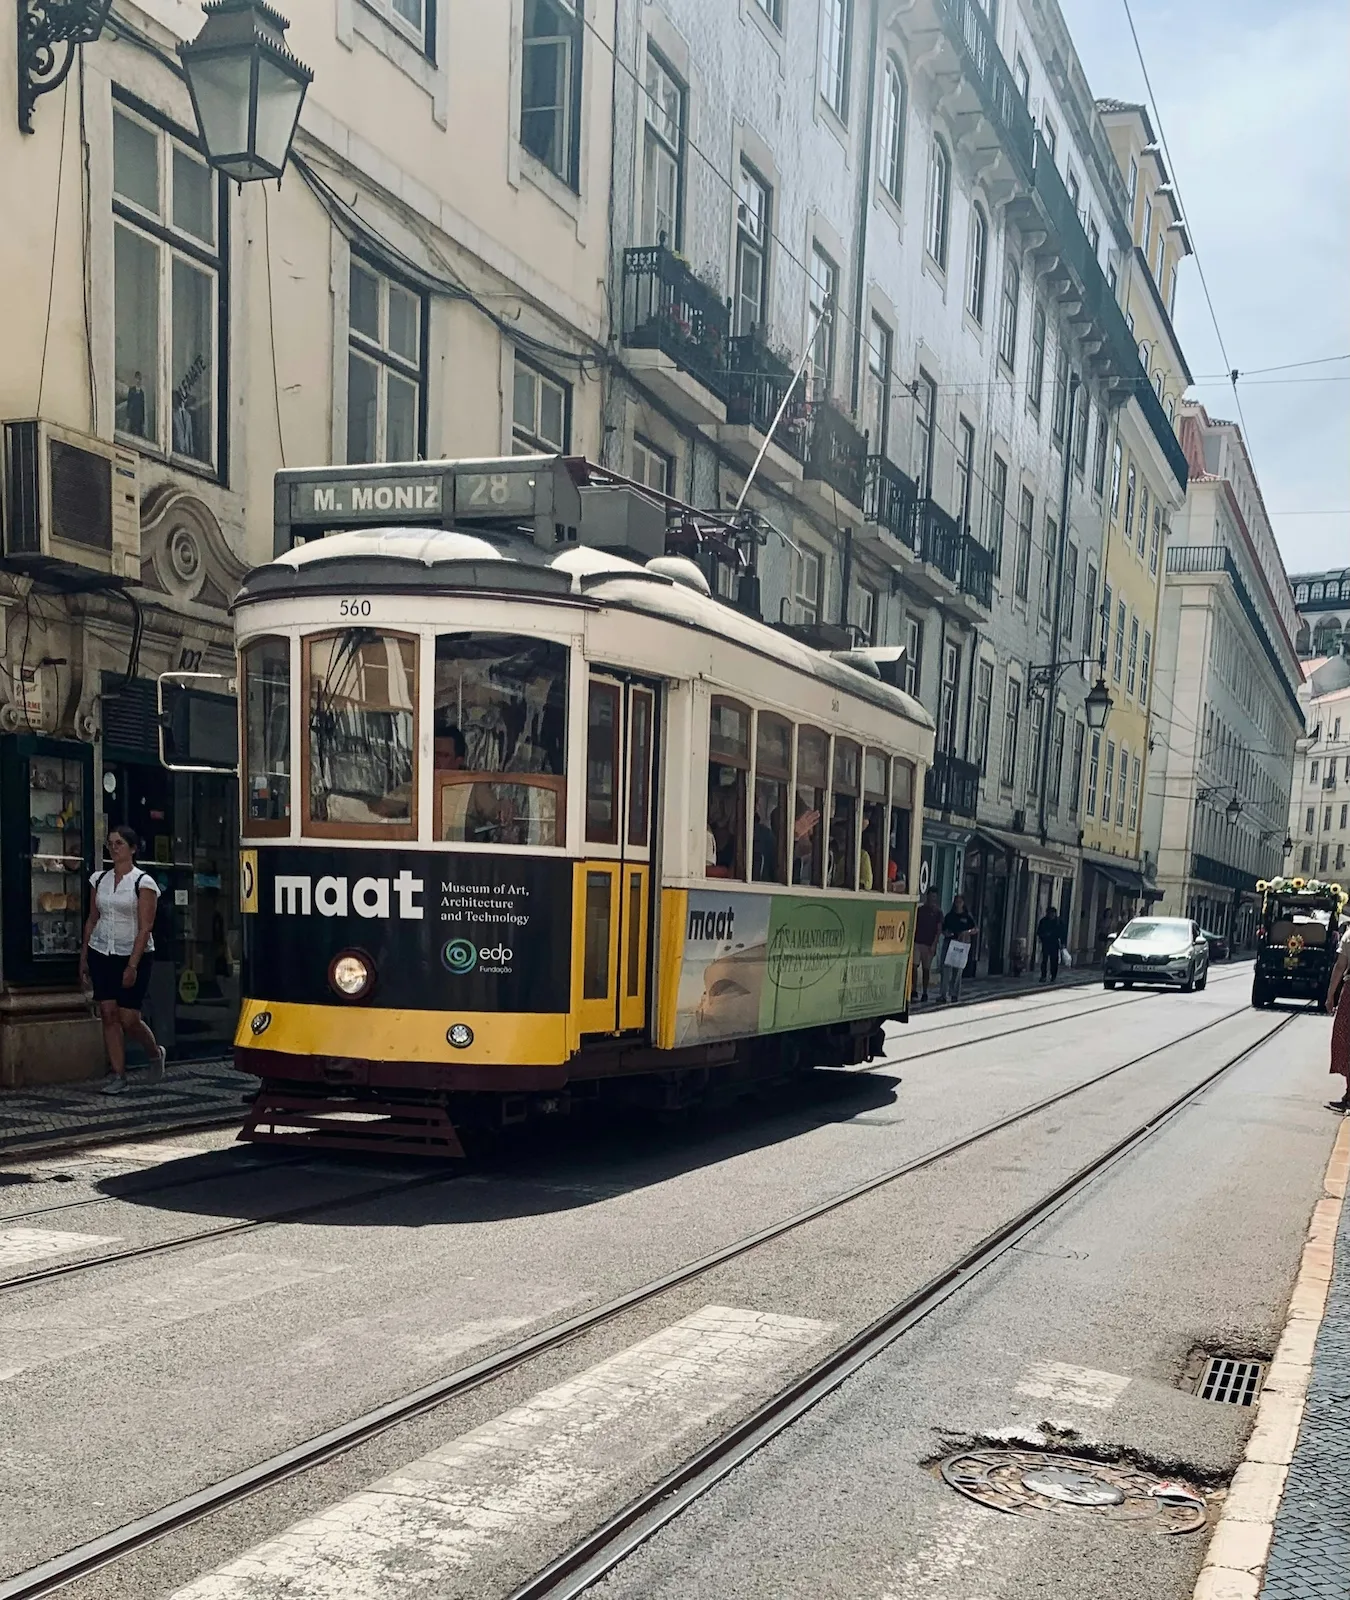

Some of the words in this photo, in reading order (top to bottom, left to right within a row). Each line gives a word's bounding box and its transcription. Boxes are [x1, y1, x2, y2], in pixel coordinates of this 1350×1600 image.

[313, 488, 342, 511] M.
[351, 485, 439, 510] MONIZ
[468, 473, 510, 505] 28
[339, 599, 371, 616] 560
[274, 870, 424, 919] maat
[441, 881, 490, 894] Museum
[493, 884, 506, 895] of
[507, 884, 530, 897] Art,
[440, 896, 514, 909] Architecture
[440, 910, 462, 921] and
[464, 911, 530, 926] Technology
[688, 906, 735, 940] maat
[479, 942, 513, 965] edp
[479, 965, 513, 974] Fundação
